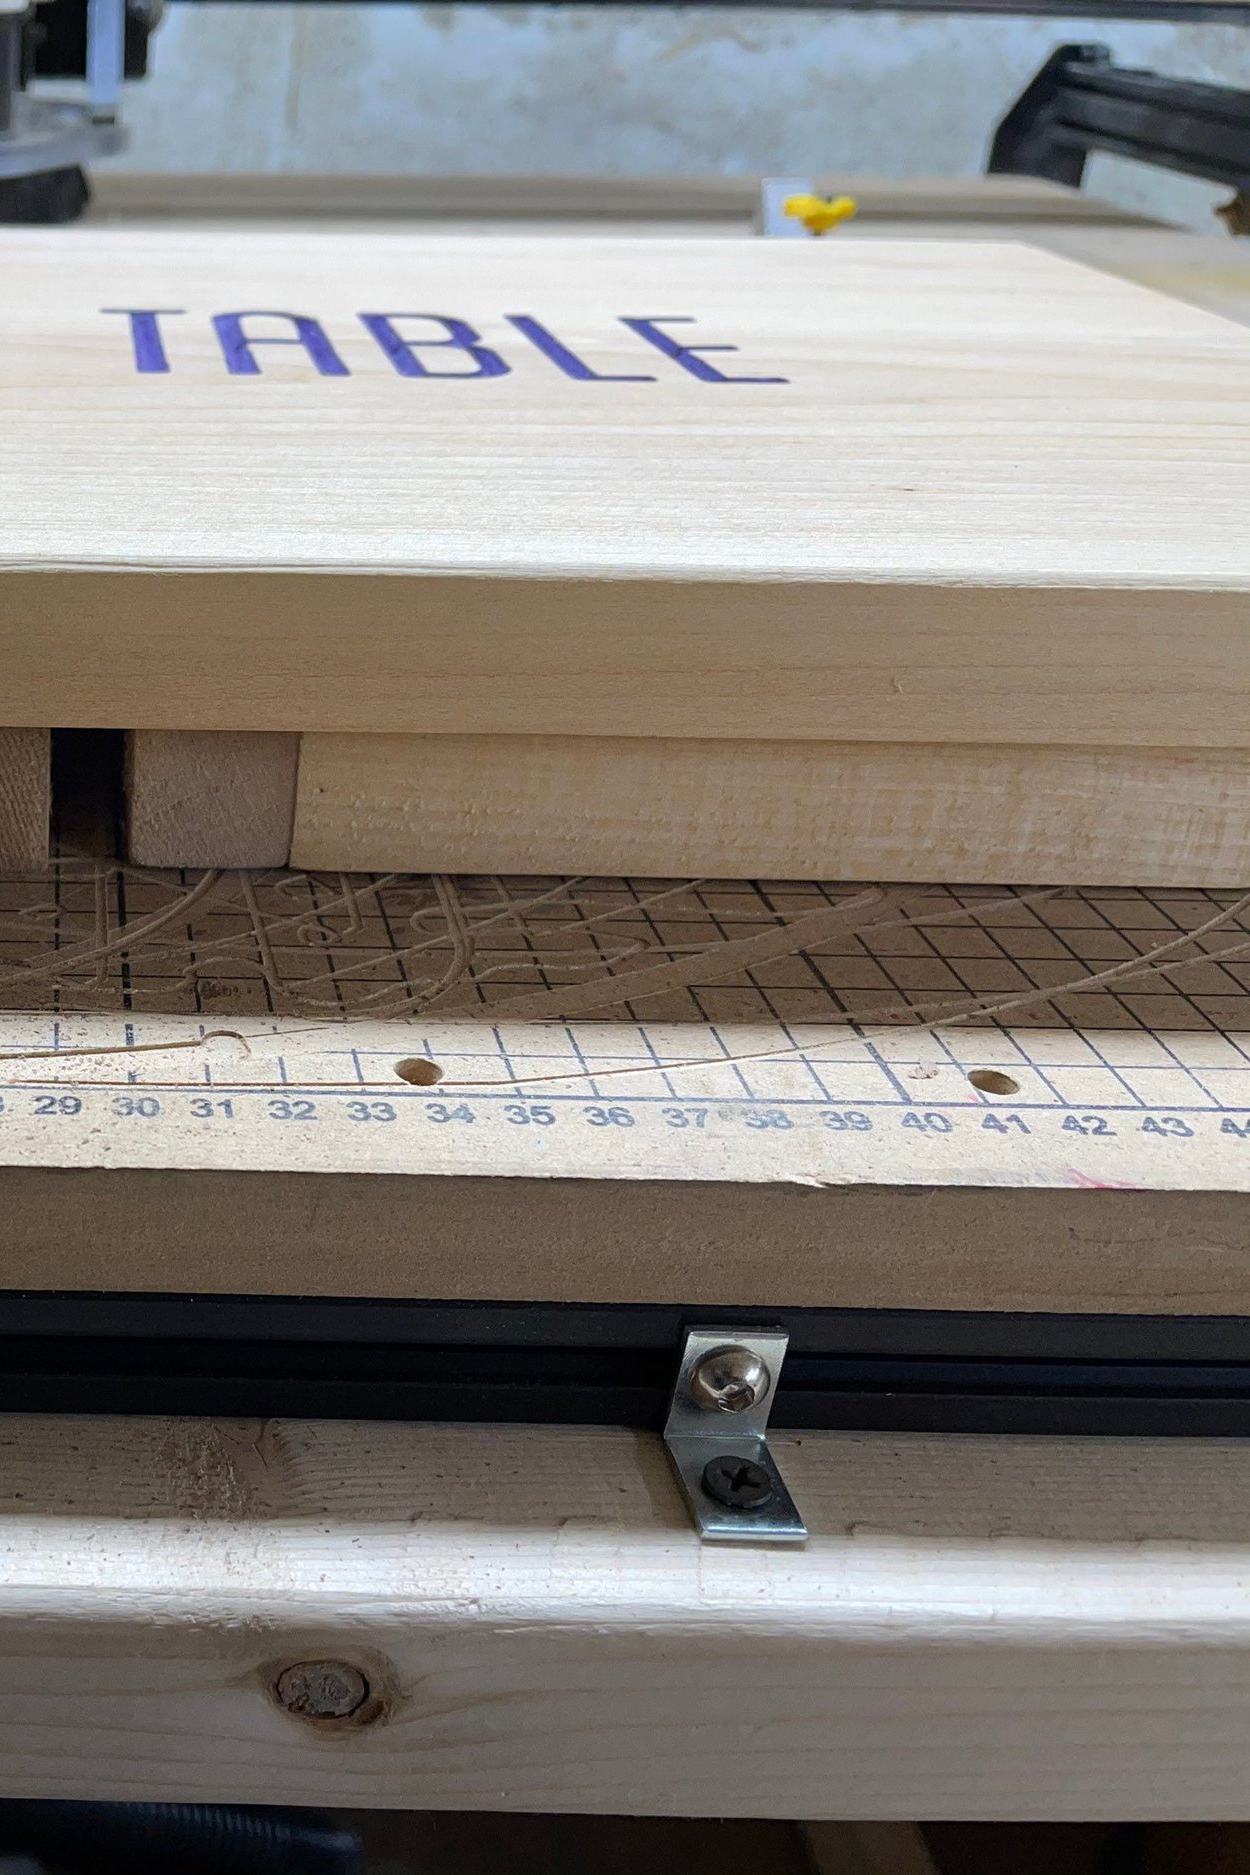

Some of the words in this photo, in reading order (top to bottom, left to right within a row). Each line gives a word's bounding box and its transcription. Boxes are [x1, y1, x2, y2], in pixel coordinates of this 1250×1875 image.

[99, 308, 791, 383] TABLE
[33, 1096, 82, 1116] 29
[111, 1097, 160, 1117] 30
[190, 1098, 234, 1119] 31
[268, 1100, 317, 1121] 32
[349, 1101, 397, 1122] 33
[425, 1102, 476, 1123] 34
[503, 1105, 556, 1125] 35
[582, 1106, 635, 1128] 36
[661, 1107, 708, 1128] 37
[741, 1109, 794, 1130] 38
[819, 1111, 872, 1132] 39
[900, 1112, 952, 1134] 40
[980, 1114, 1032, 1135] 41
[1061, 1115, 1118, 1137] 42
[1141, 1117, 1195, 1138] 43
[1220, 1118, 1250, 1138] 4
